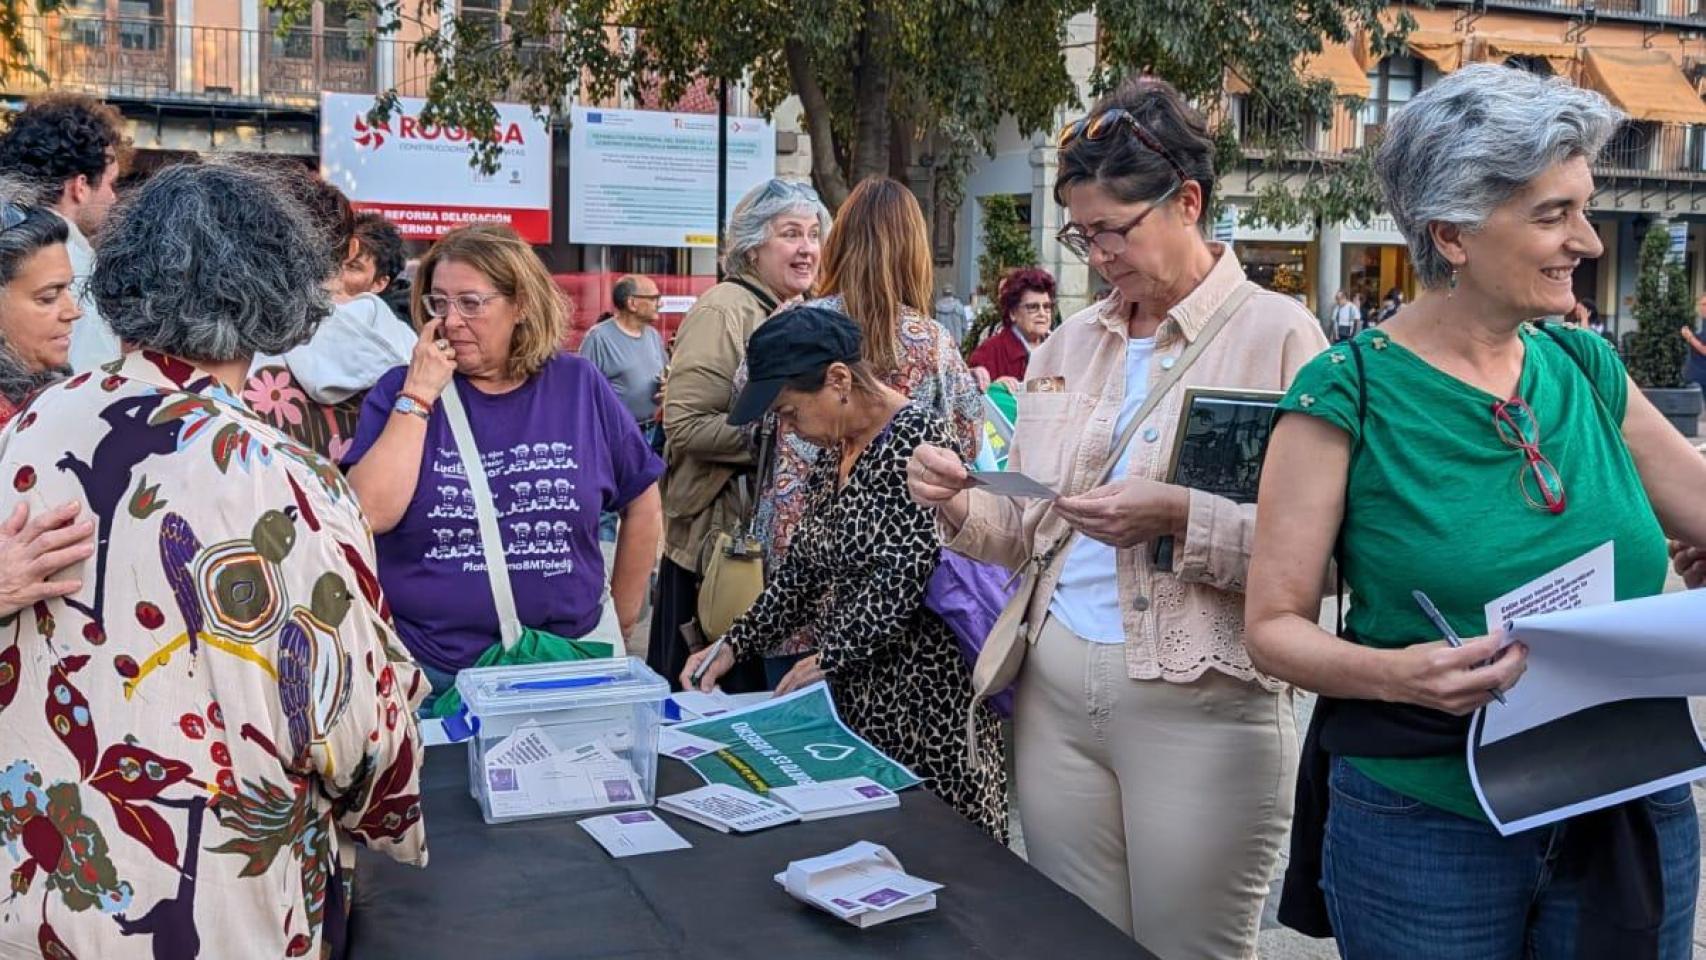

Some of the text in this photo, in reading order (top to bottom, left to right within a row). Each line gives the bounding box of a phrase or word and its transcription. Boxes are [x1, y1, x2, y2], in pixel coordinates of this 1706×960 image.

[400, 115, 524, 145] ROGSA
[383, 209, 439, 221] REFORMA
[441, 211, 512, 223] DELEGACIÓN
[398, 224, 432, 233] ERNO
